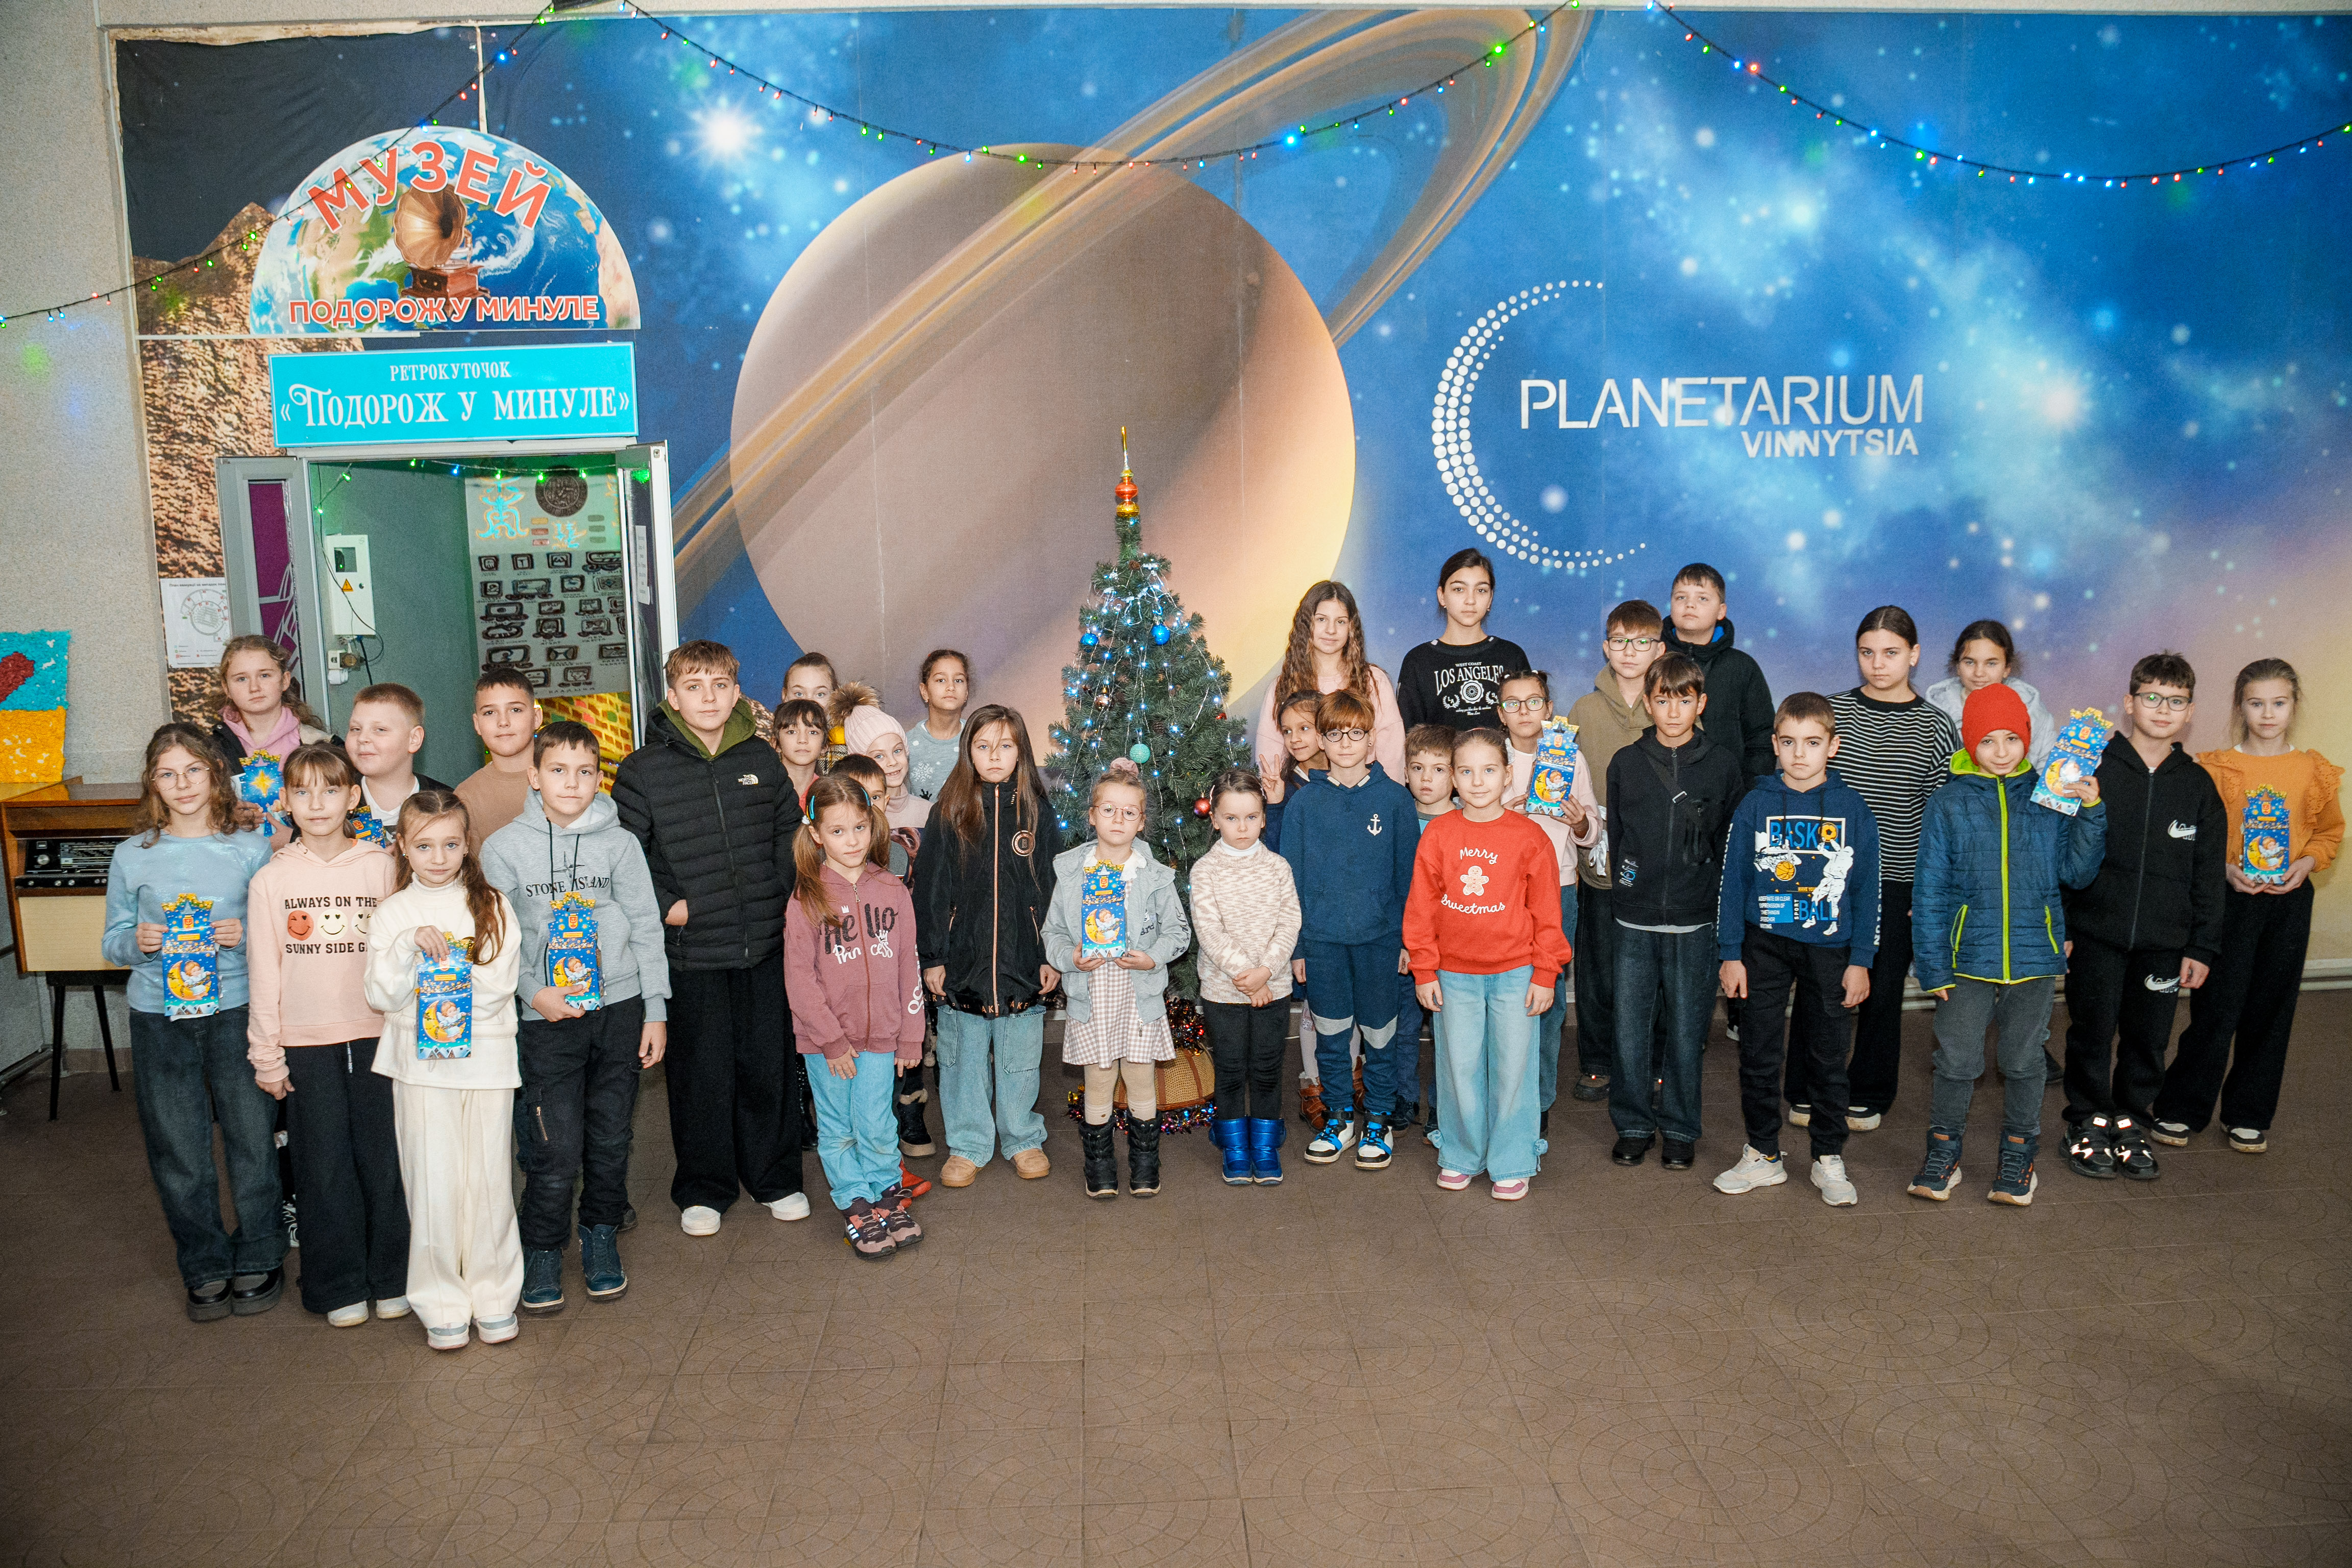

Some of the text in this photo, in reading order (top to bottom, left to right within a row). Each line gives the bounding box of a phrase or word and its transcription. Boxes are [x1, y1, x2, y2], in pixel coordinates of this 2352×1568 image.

[307, 140, 552, 233] МУЗЕЙ
[289, 296, 600, 328] ПОДОРОЖ У МИНУЛЕ
[1521, 374, 1924, 429] PLANETARIUM
[1741, 428, 1919, 458] VINNYTSIA
[1434, 668, 1455, 696] LOS
[1460, 846, 1498, 865] Merry
[526, 881, 566, 897] STONE
[285, 896, 377, 909] ALWAYS ON THE
[1441, 894, 1506, 915] Sweetmas
[1799, 900, 1837, 921] BALL
[286, 943, 322, 954] SUNNY
[326, 943, 354, 953] SIDE
[832, 941, 893, 965] Princess
